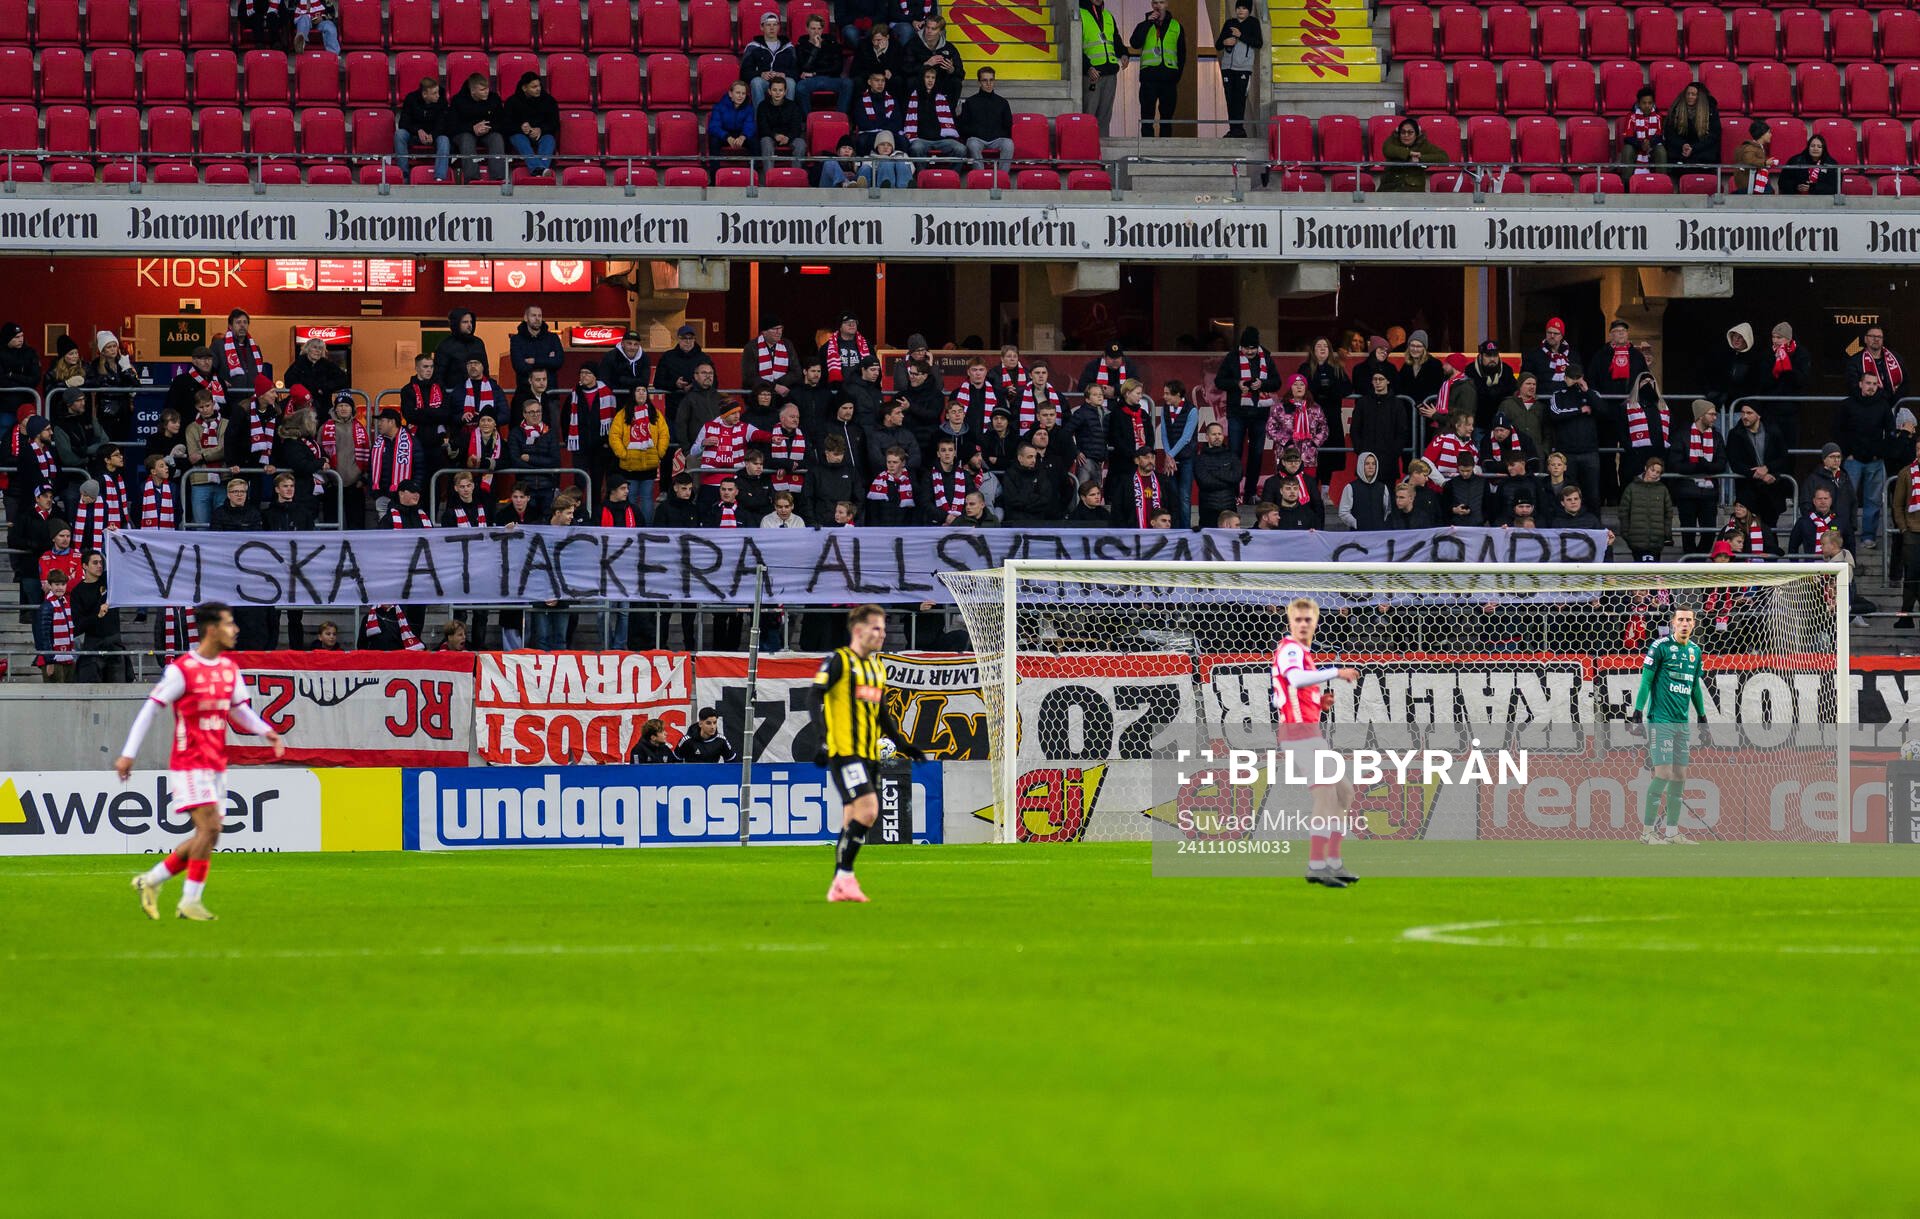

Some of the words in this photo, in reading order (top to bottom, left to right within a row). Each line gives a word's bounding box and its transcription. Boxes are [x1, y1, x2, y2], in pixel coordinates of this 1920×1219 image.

[128, 207, 296, 240] Barometern
[325, 208, 493, 241] Barometern
[522, 210, 690, 243] Barometern
[717, 212, 883, 245] Barometern
[911, 213, 1078, 246] Barometern
[1104, 215, 1269, 248] Barometern
[1293, 216, 1457, 249] Barometern
[1484, 218, 1648, 250] Barometern
[1675, 219, 1839, 252] Barometern
[137, 257, 248, 288] KIOSK
[1833, 314, 1880, 325] TOALETT
[136, 411, 160, 421] Grö
[234, 540, 369, 604] SKA
[401, 531, 775, 601] ATTACKERA
[479, 654, 687, 704] KURVAN
[885, 664, 925, 685] TIFO
[384, 677, 454, 740] RC
[1037, 683, 1181, 760] 20
[1216, 672, 1577, 751] KALMR
[881, 778, 899, 842] SELECT
